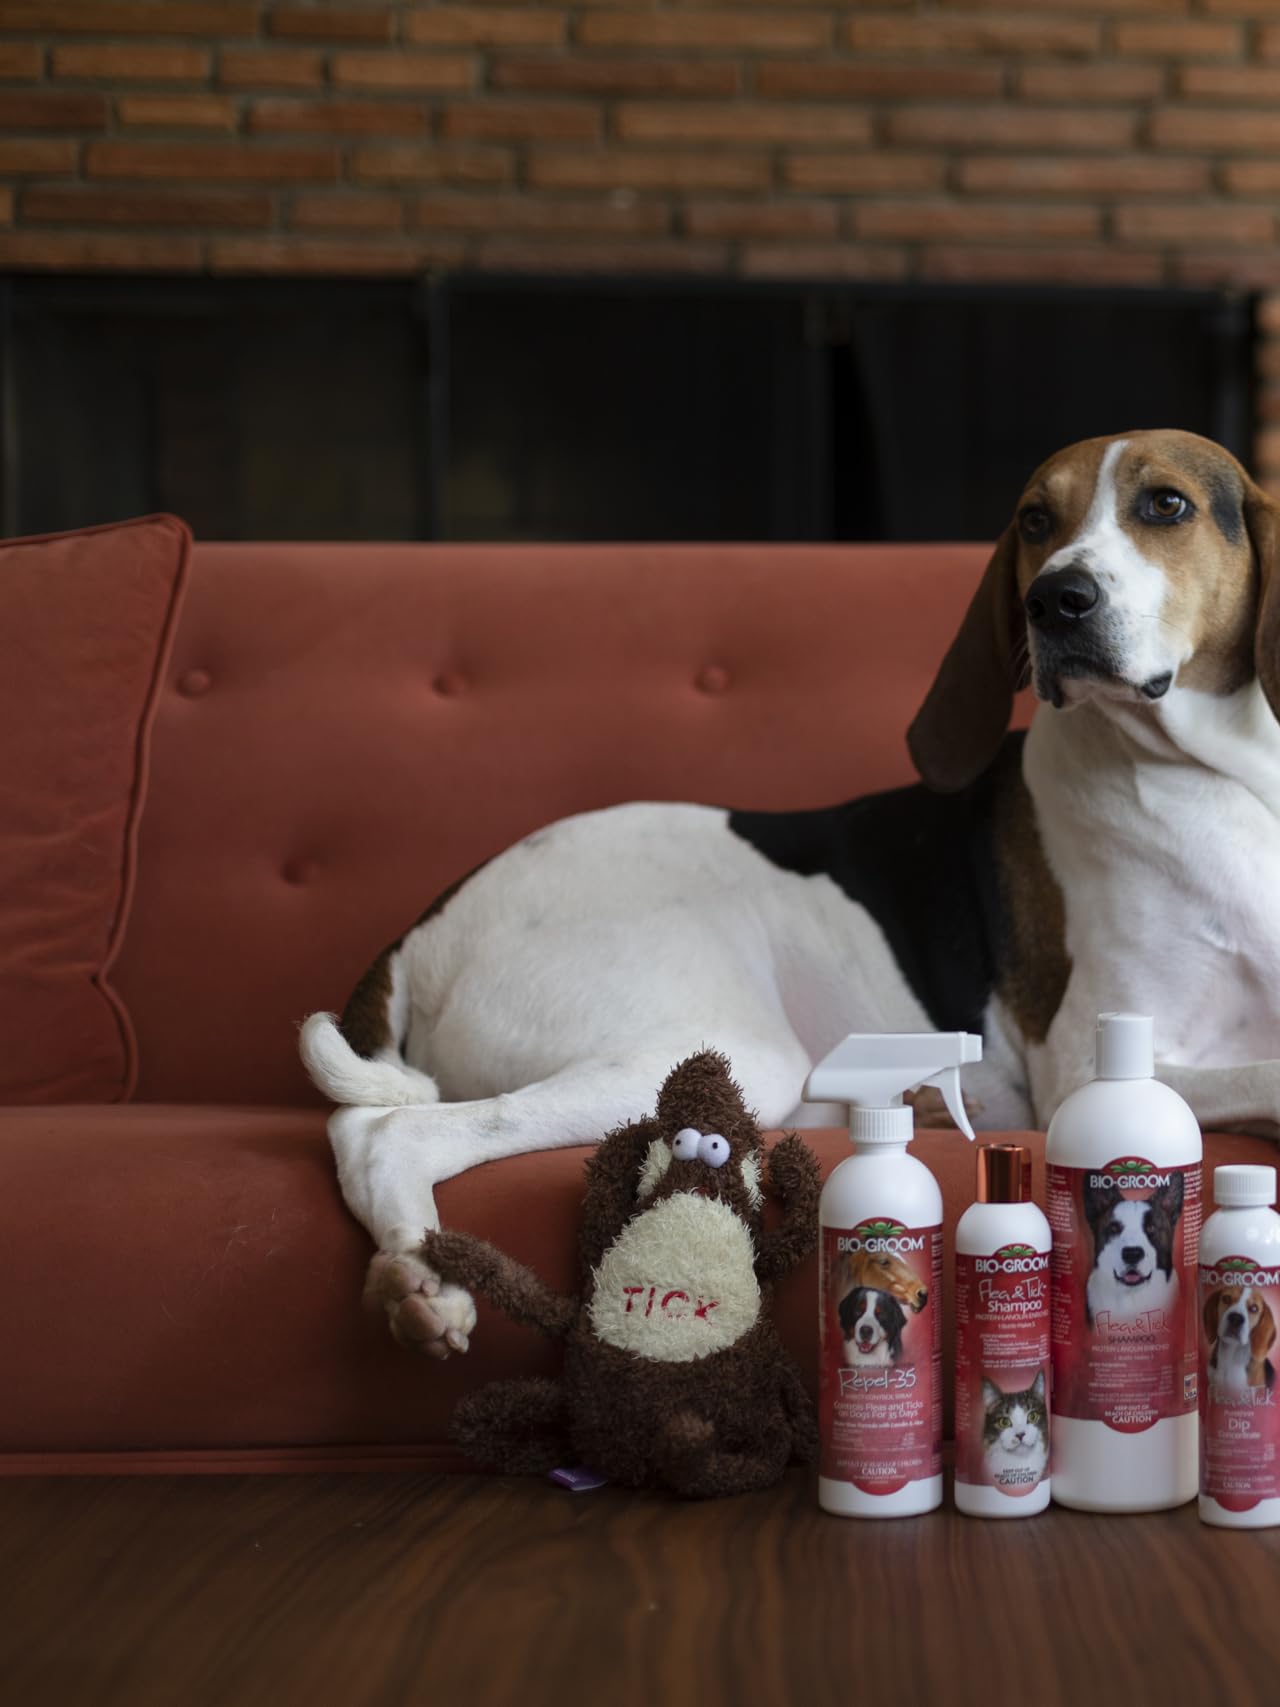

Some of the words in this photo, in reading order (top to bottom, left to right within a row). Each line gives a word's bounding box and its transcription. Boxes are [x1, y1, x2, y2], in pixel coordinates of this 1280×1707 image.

[1090, 1174, 1170, 1189] BIO-GROOM
[838, 1237, 923, 1252] BIO-GROOM
[976, 1257, 1048, 1273] BIO-GROOM
[979, 1279, 1010, 1302] Flea
[1011, 1286, 1025, 1300] &
[1021, 1276, 1045, 1298] Tick
[623, 1286, 719, 1325] TICK
[987, 1300, 1042, 1314] Shampoo
[1095, 1310, 1132, 1336] Flea
[1132, 1318, 1145, 1333] &
[1140, 1309, 1170, 1333] Tick
[1108, 1335, 1155, 1344] SHAMPOO
[838, 1368, 916, 1396] Repel-35
[1250, 1385, 1276, 1408] Tick
[888, 1401, 904, 1410] and
[850, 1410, 870, 1420] Dogs
[872, 1410, 886, 1418] For
[898, 1409, 918, 1419] Days
[1111, 1415, 1152, 1424] CAUTION
[1228, 1418, 1251, 1433] Dip
[862, 1467, 897, 1475] CAUTION
[999, 1476, 1034, 1485] CAUTION
